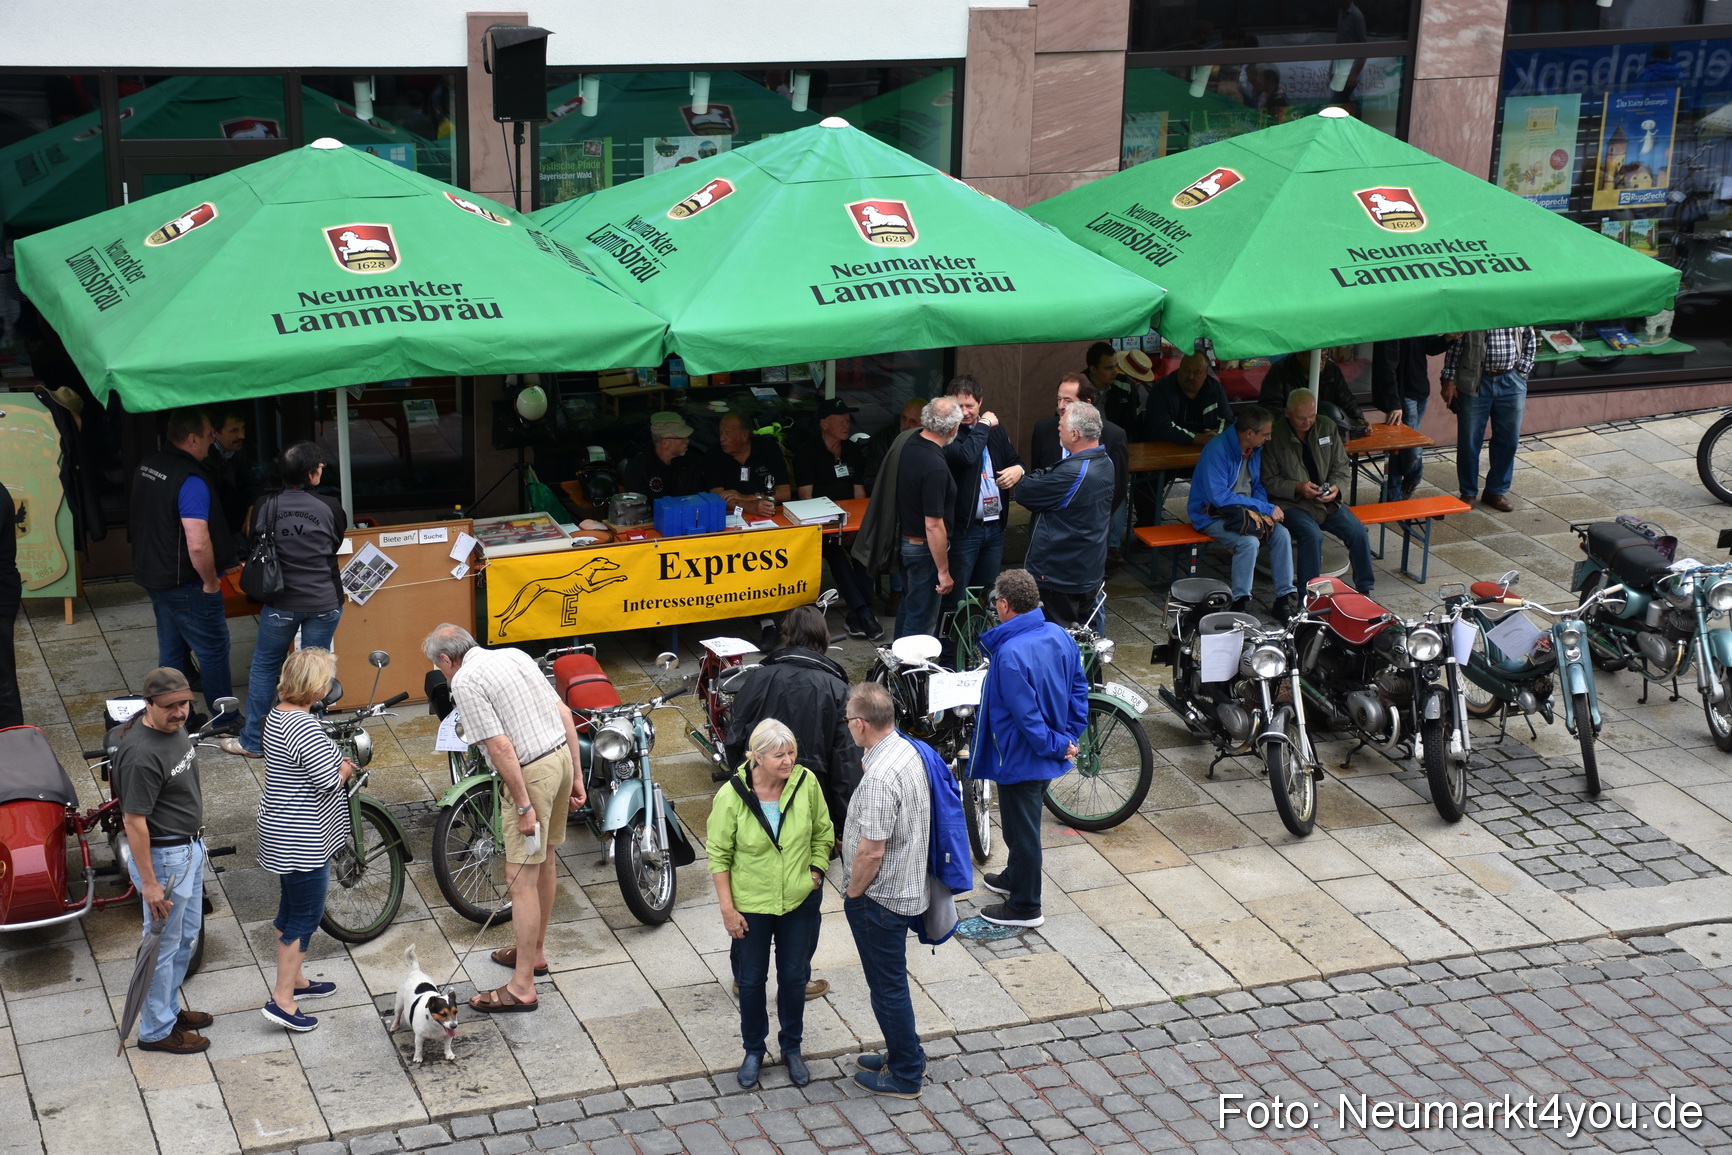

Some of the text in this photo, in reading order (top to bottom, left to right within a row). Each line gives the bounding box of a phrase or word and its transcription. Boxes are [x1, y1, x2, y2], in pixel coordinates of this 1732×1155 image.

[539, 159, 601, 172] ystische Pfade
[539, 171, 593, 181] Bayerischer Wald
[1631, 190, 1666, 202] Rupprecht
[1125, 202, 1192, 243] Neumarkter
[1391, 220, 1417, 229] 1628
[625, 214, 678, 257] Neumarkter
[880, 234, 906, 244] 1628
[1085, 212, 1178, 268] Lammsbräu
[104, 237, 147, 286] Neumarkter
[585, 222, 661, 284] Lammsbräu
[1346, 238, 1488, 263] Neumarkter
[356, 260, 386, 270] 1628
[830, 255, 976, 279] Neumarkter
[1329, 253, 1532, 288] Lammsbräu
[65, 246, 124, 312] Lammsbräu
[809, 272, 1017, 306] Lammsbräu
[297, 280, 463, 307] Neumarkter
[271, 298, 504, 335] Lammsbräu
[281, 525, 306, 536] e.V.
[383, 536, 402, 544] Biete
[423, 533, 445, 541] Suche:
[17, 550, 54, 560] ARKT
[18, 560, 47, 569] BERG
[657, 547, 789, 585] Express
[622, 580, 808, 613] Interessengemeinschaft
[956, 679, 977, 688] 267
[1112, 686, 1142, 708] SDL 108
